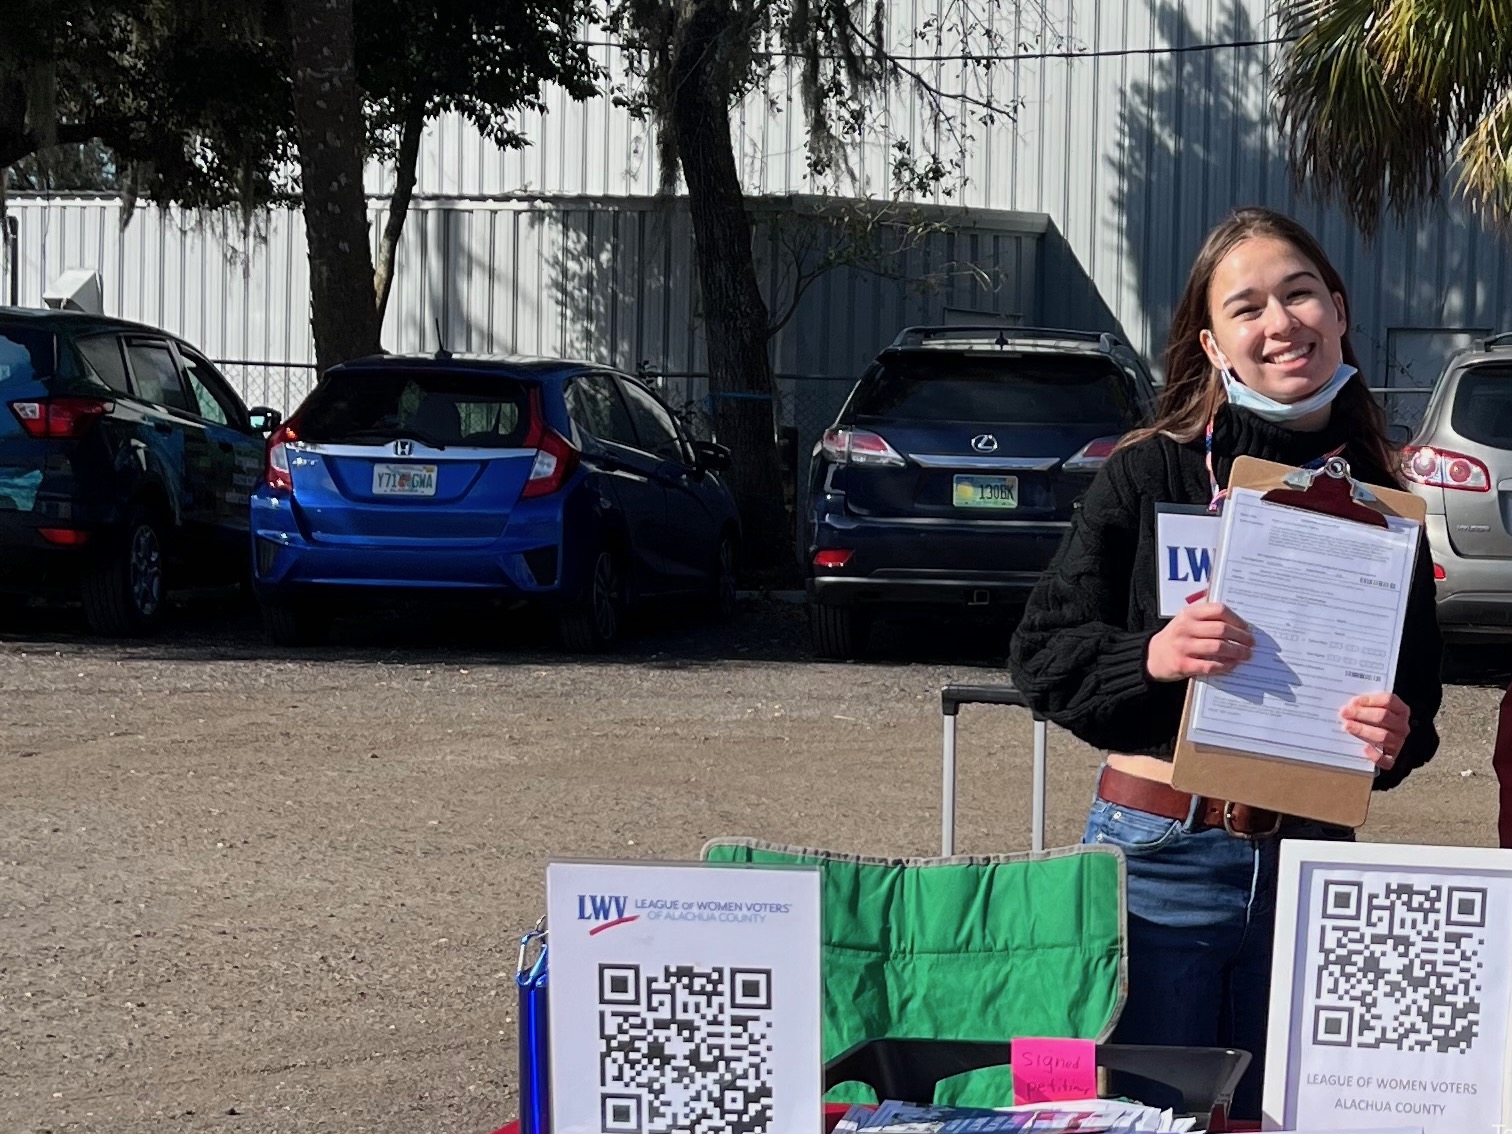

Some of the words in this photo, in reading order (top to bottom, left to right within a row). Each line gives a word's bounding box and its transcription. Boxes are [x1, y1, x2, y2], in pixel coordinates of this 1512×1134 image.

[1166, 545, 1217, 582] LW
[577, 894, 628, 921] LWV
[635, 899, 680, 909] LEAGUE
[697, 901, 743, 912] WOMEN
[647, 912, 664, 920] OF
[665, 912, 717, 921] ALACHUA
[719, 913, 767, 923] COUNTY
[1306, 1073, 1354, 1088] LEAGUE
[1356, 1076, 1374, 1088] OF
[1376, 1078, 1427, 1092] WOMEN
[1431, 1081, 1478, 1095] VOTERS
[1334, 1098, 1392, 1112] ALACHUA
[1395, 1102, 1446, 1116] COUNTY
